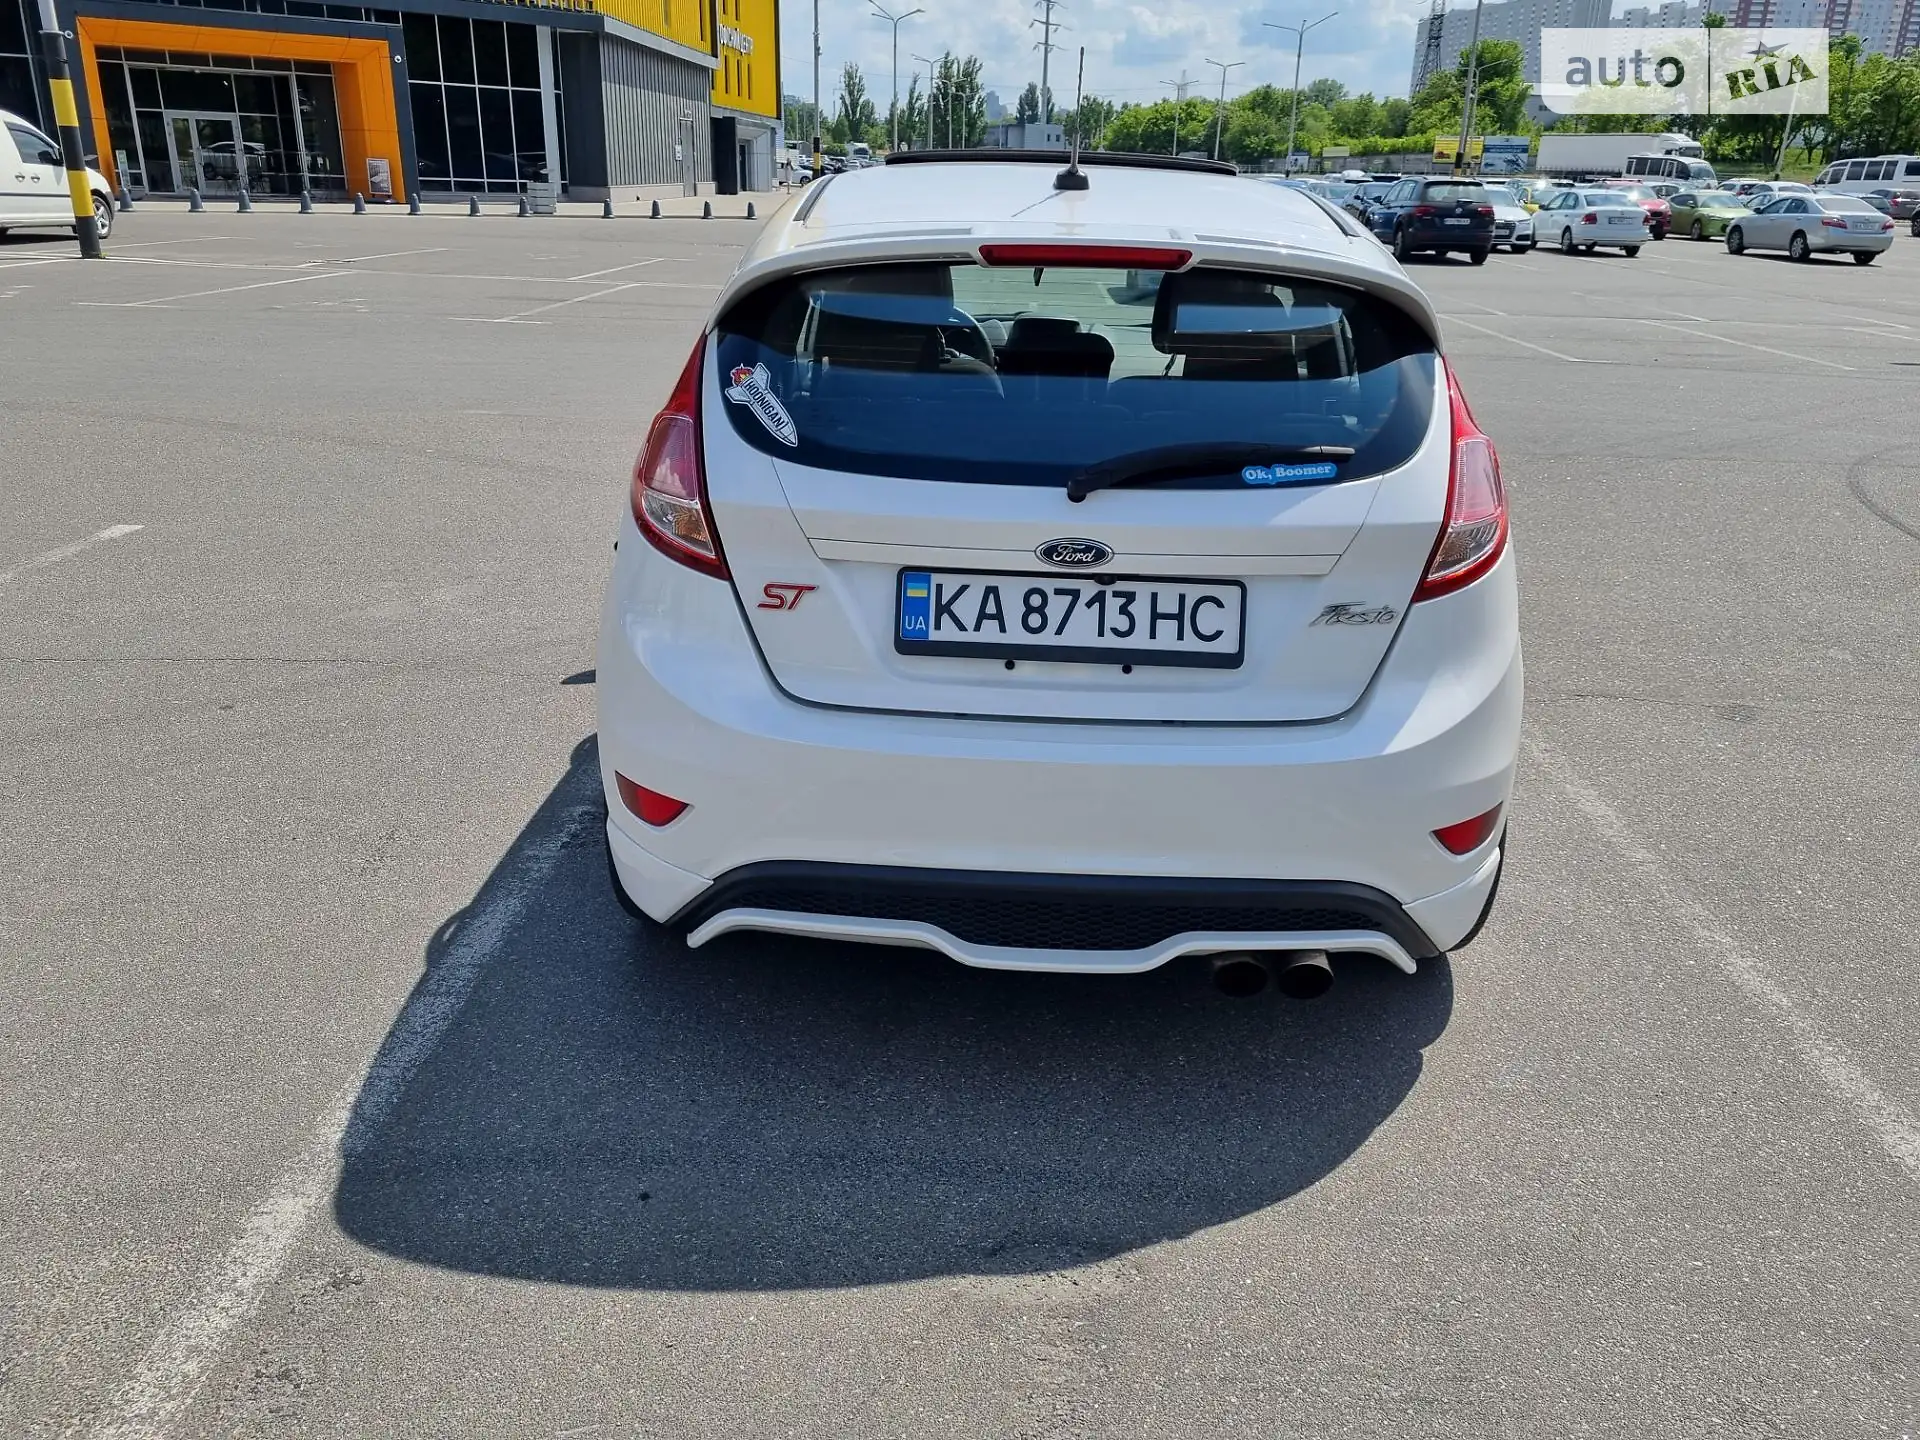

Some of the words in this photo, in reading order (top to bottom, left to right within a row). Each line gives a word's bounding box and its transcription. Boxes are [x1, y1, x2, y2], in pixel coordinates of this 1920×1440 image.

[744, 380, 786, 429] HOONIGAN
[1245, 468, 1272, 480] Ok,
[1274, 465, 1332, 478] Boomer
[1052, 543, 1096, 562] Ford
[757, 582, 819, 610] ST
[904, 614, 926, 631] UA
[934, 583, 1007, 634] KA
[1020, 587, 1137, 638] 8713
[1149, 590, 1226, 643] HC
